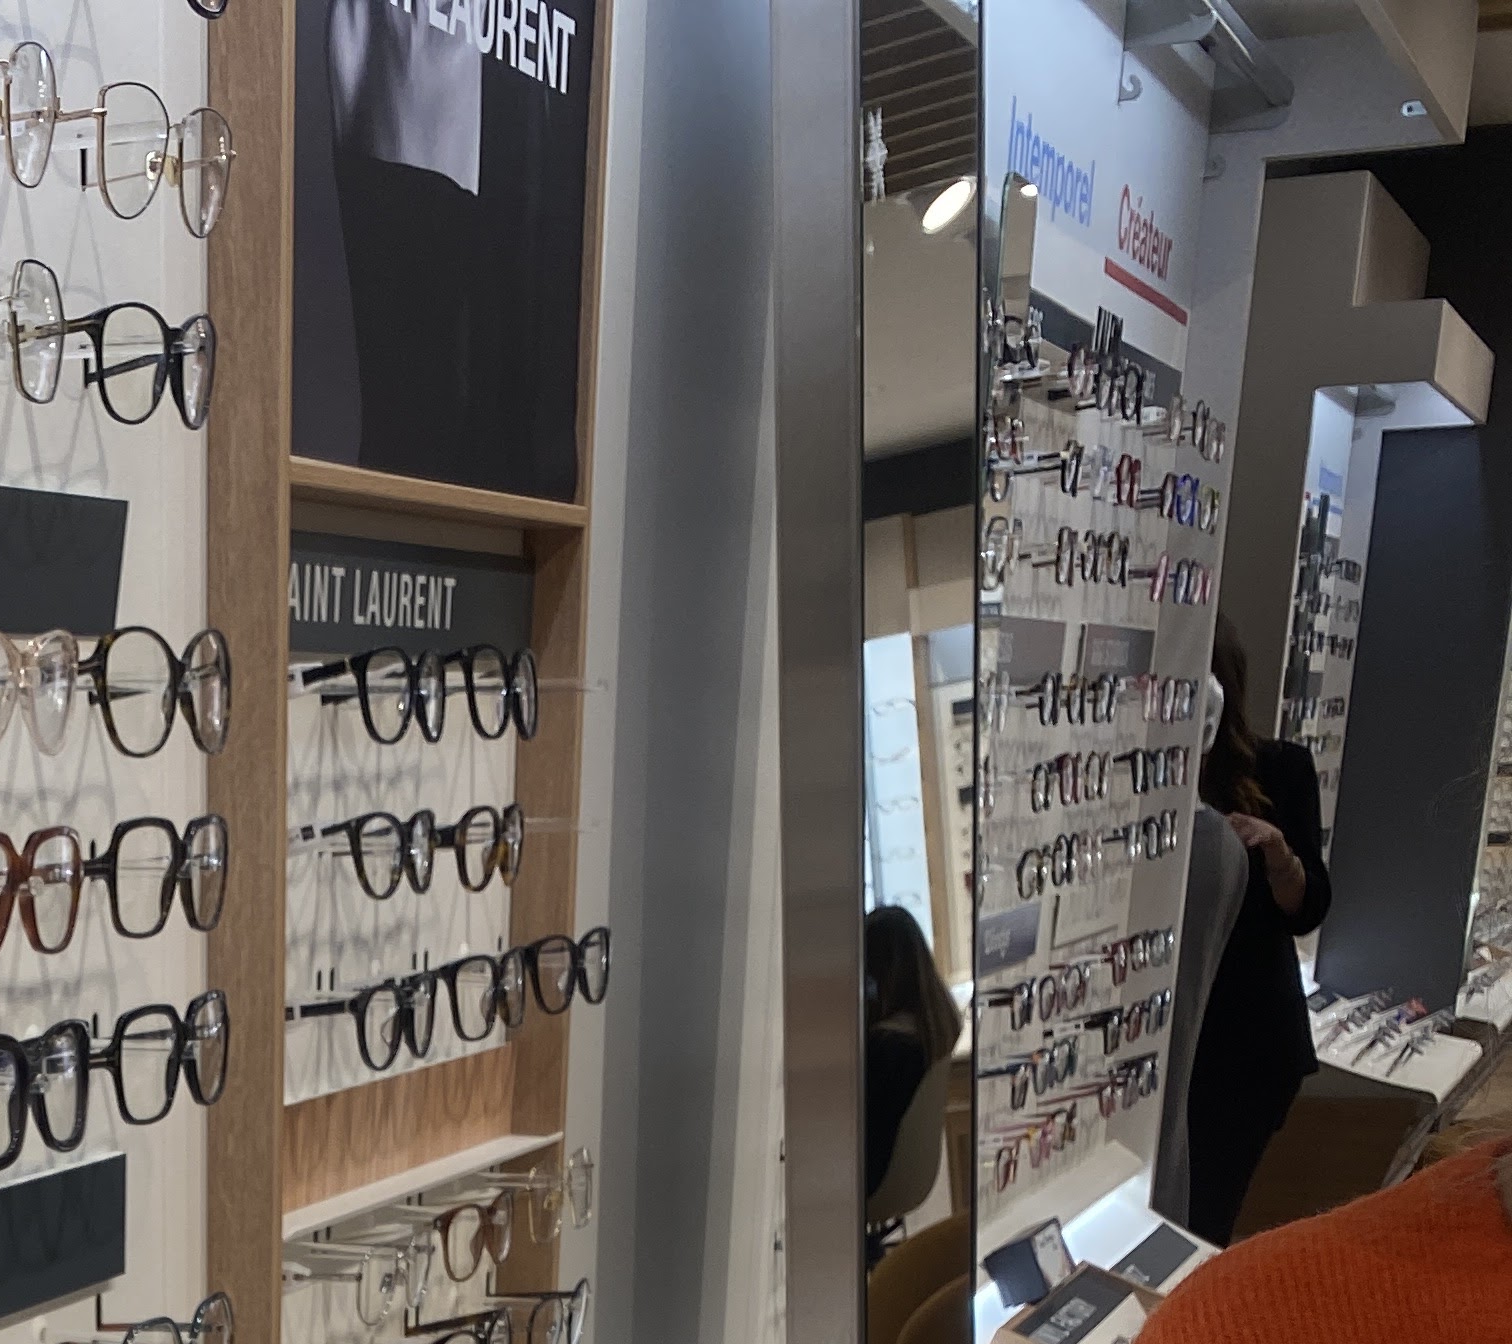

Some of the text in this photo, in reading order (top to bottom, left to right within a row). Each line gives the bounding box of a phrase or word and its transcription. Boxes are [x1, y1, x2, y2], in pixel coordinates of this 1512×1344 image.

[1008, 95, 1096, 228] Intemporel
[1119, 184, 1173, 281] Créateur
[353, 569, 457, 629] LAURENT
